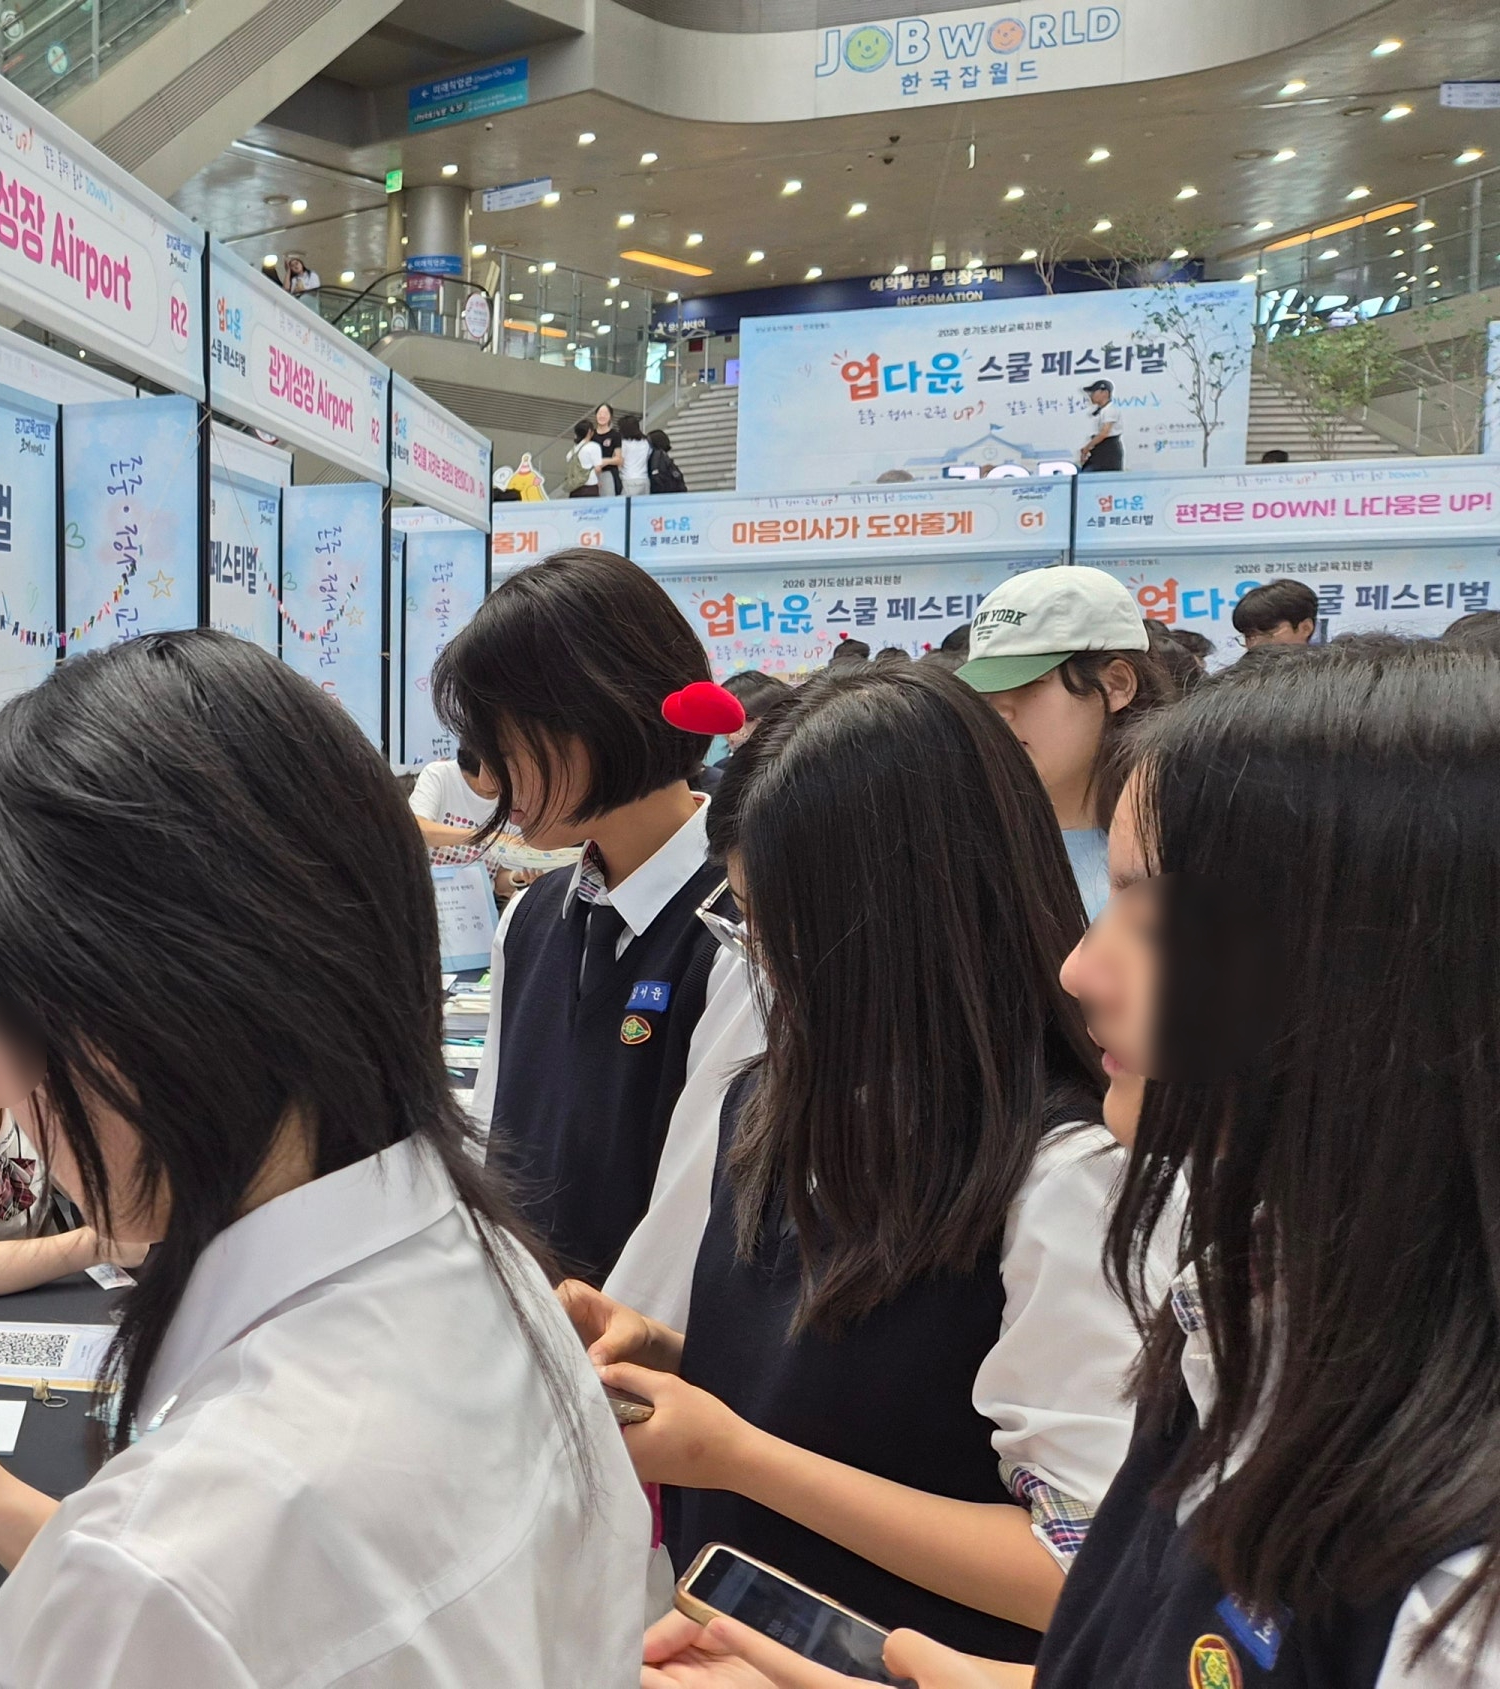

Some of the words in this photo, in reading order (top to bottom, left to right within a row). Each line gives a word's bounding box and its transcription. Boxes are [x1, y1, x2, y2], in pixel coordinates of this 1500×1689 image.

[815, 18, 930, 78] JOB
[939, 6, 1121, 59] WORLD
[901, 60, 1038, 95] 한국잡월드
[51, 212, 132, 311] Airport
[897, 290, 984, 307] INFORMATION
[170, 296, 188, 338] R2
[269, 345, 315, 414] 관계성장
[317, 379, 353, 433] Airport
[841, 352, 965, 402] 업다운
[977, 351, 1033, 384] 스쿨
[1098, 494, 1144, 512] 업다운
[1176, 502, 1245, 524] 편견은
[1252, 498, 1336, 520] DOWN!
[1344, 494, 1441, 517] 나다움은
[1449, 492, 1492, 512] UP!
[651, 516, 691, 533] 업다운
[732, 516, 860, 544] 마음의사가
[868, 509, 973, 538] 도와줄게
[1020, 511, 1045, 528] G1
[580, 532, 602, 547] G1
[783, 579, 806, 589] 2026
[1355, 581, 1490, 613] 페스티벌
[700, 592, 814, 638] 업다운
[826, 597, 878, 625] 스쿨
[992, 609, 1028, 626] YORK
